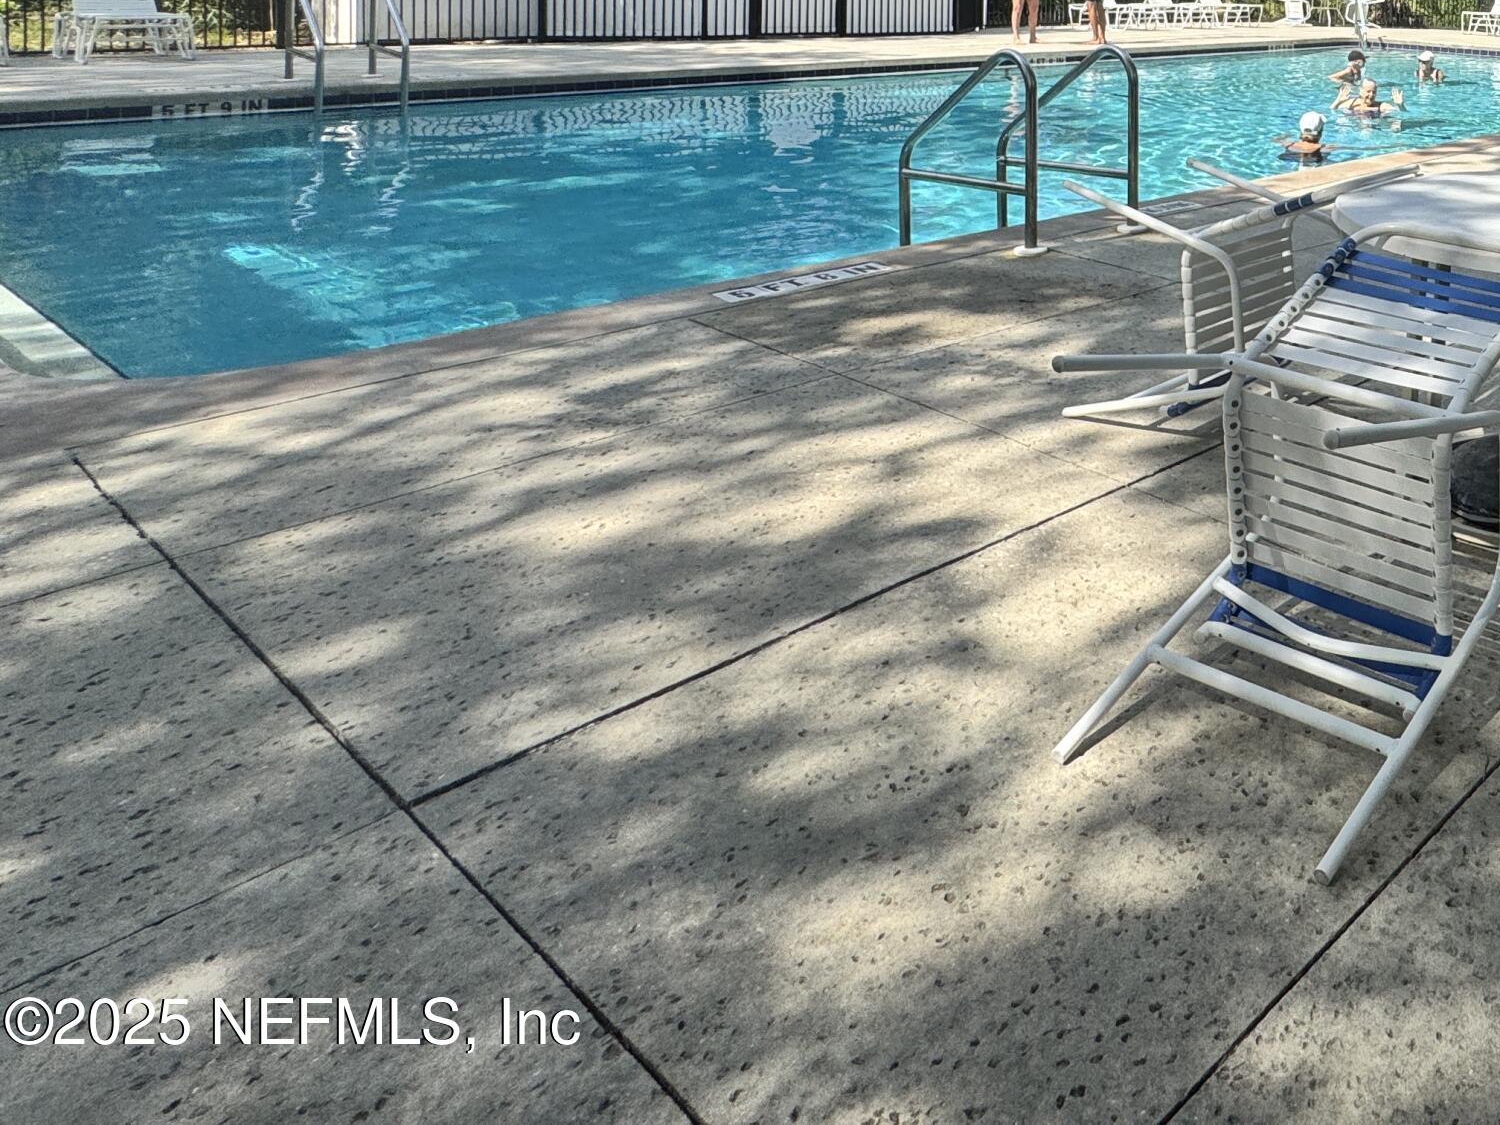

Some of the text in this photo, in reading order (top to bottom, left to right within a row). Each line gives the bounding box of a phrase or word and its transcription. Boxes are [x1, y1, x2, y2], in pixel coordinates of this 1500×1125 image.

[161, 105, 174, 116] 5
[184, 102, 210, 115] FT
[241, 98, 263, 111] IN
[845, 265, 880, 275] IN
